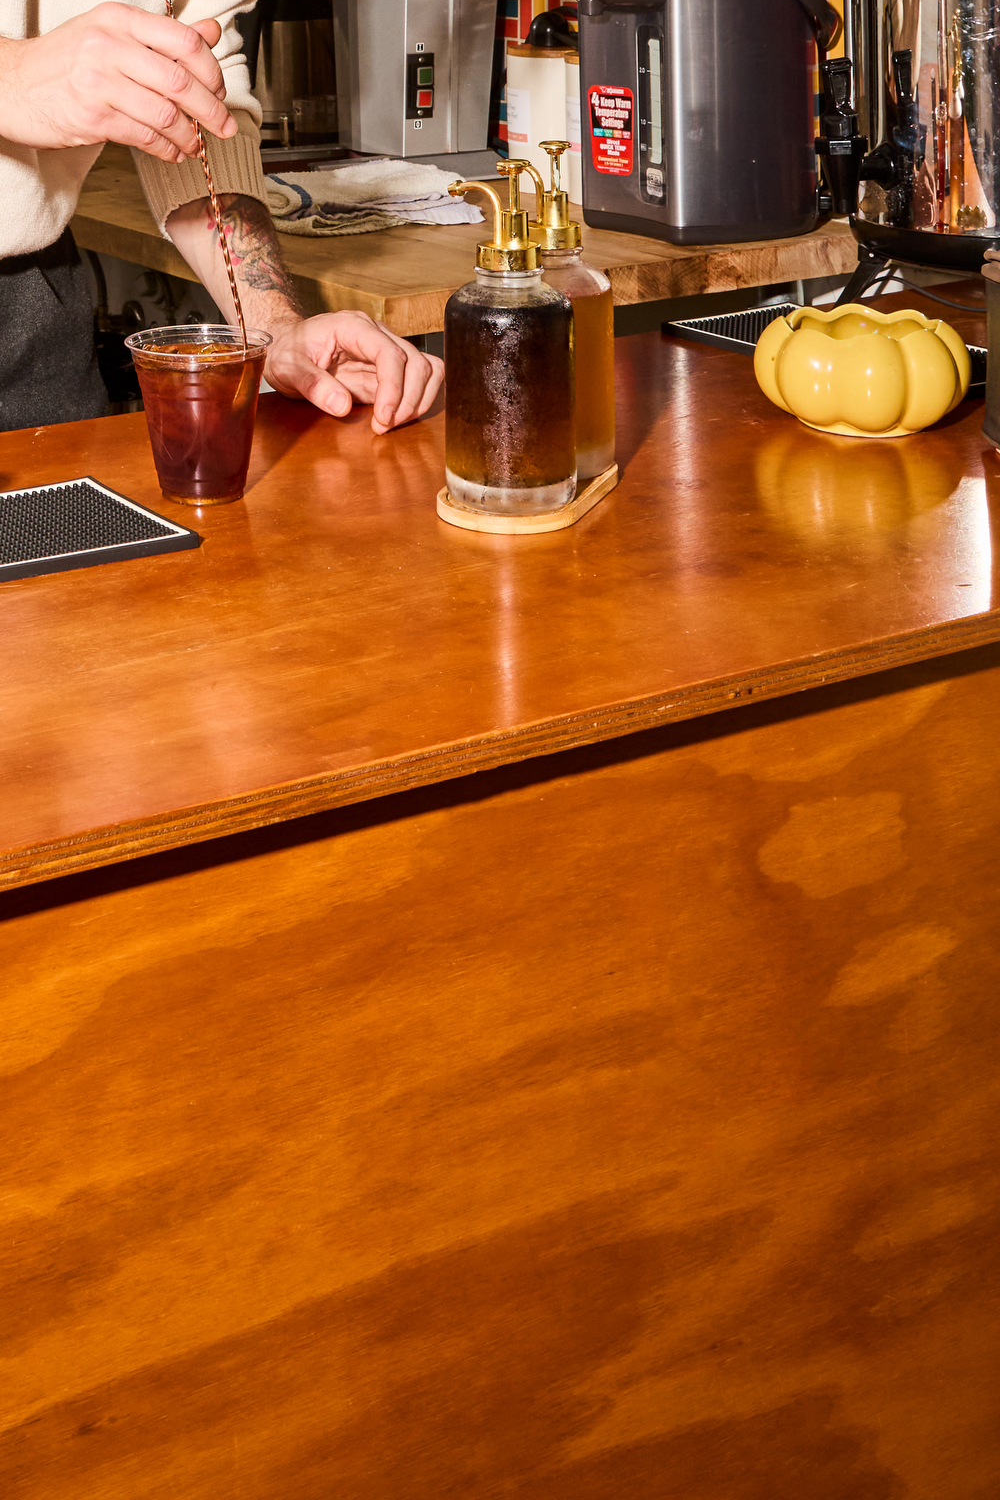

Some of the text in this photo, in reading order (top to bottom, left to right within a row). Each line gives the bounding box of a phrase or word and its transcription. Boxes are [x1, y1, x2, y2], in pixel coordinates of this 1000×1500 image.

[591, 91, 600, 106] 4
[600, 96, 615, 108] Keep
[615, 97, 632, 110] Warm
[594, 106, 629, 120] Temperature
[601, 116, 624, 130] Settings
